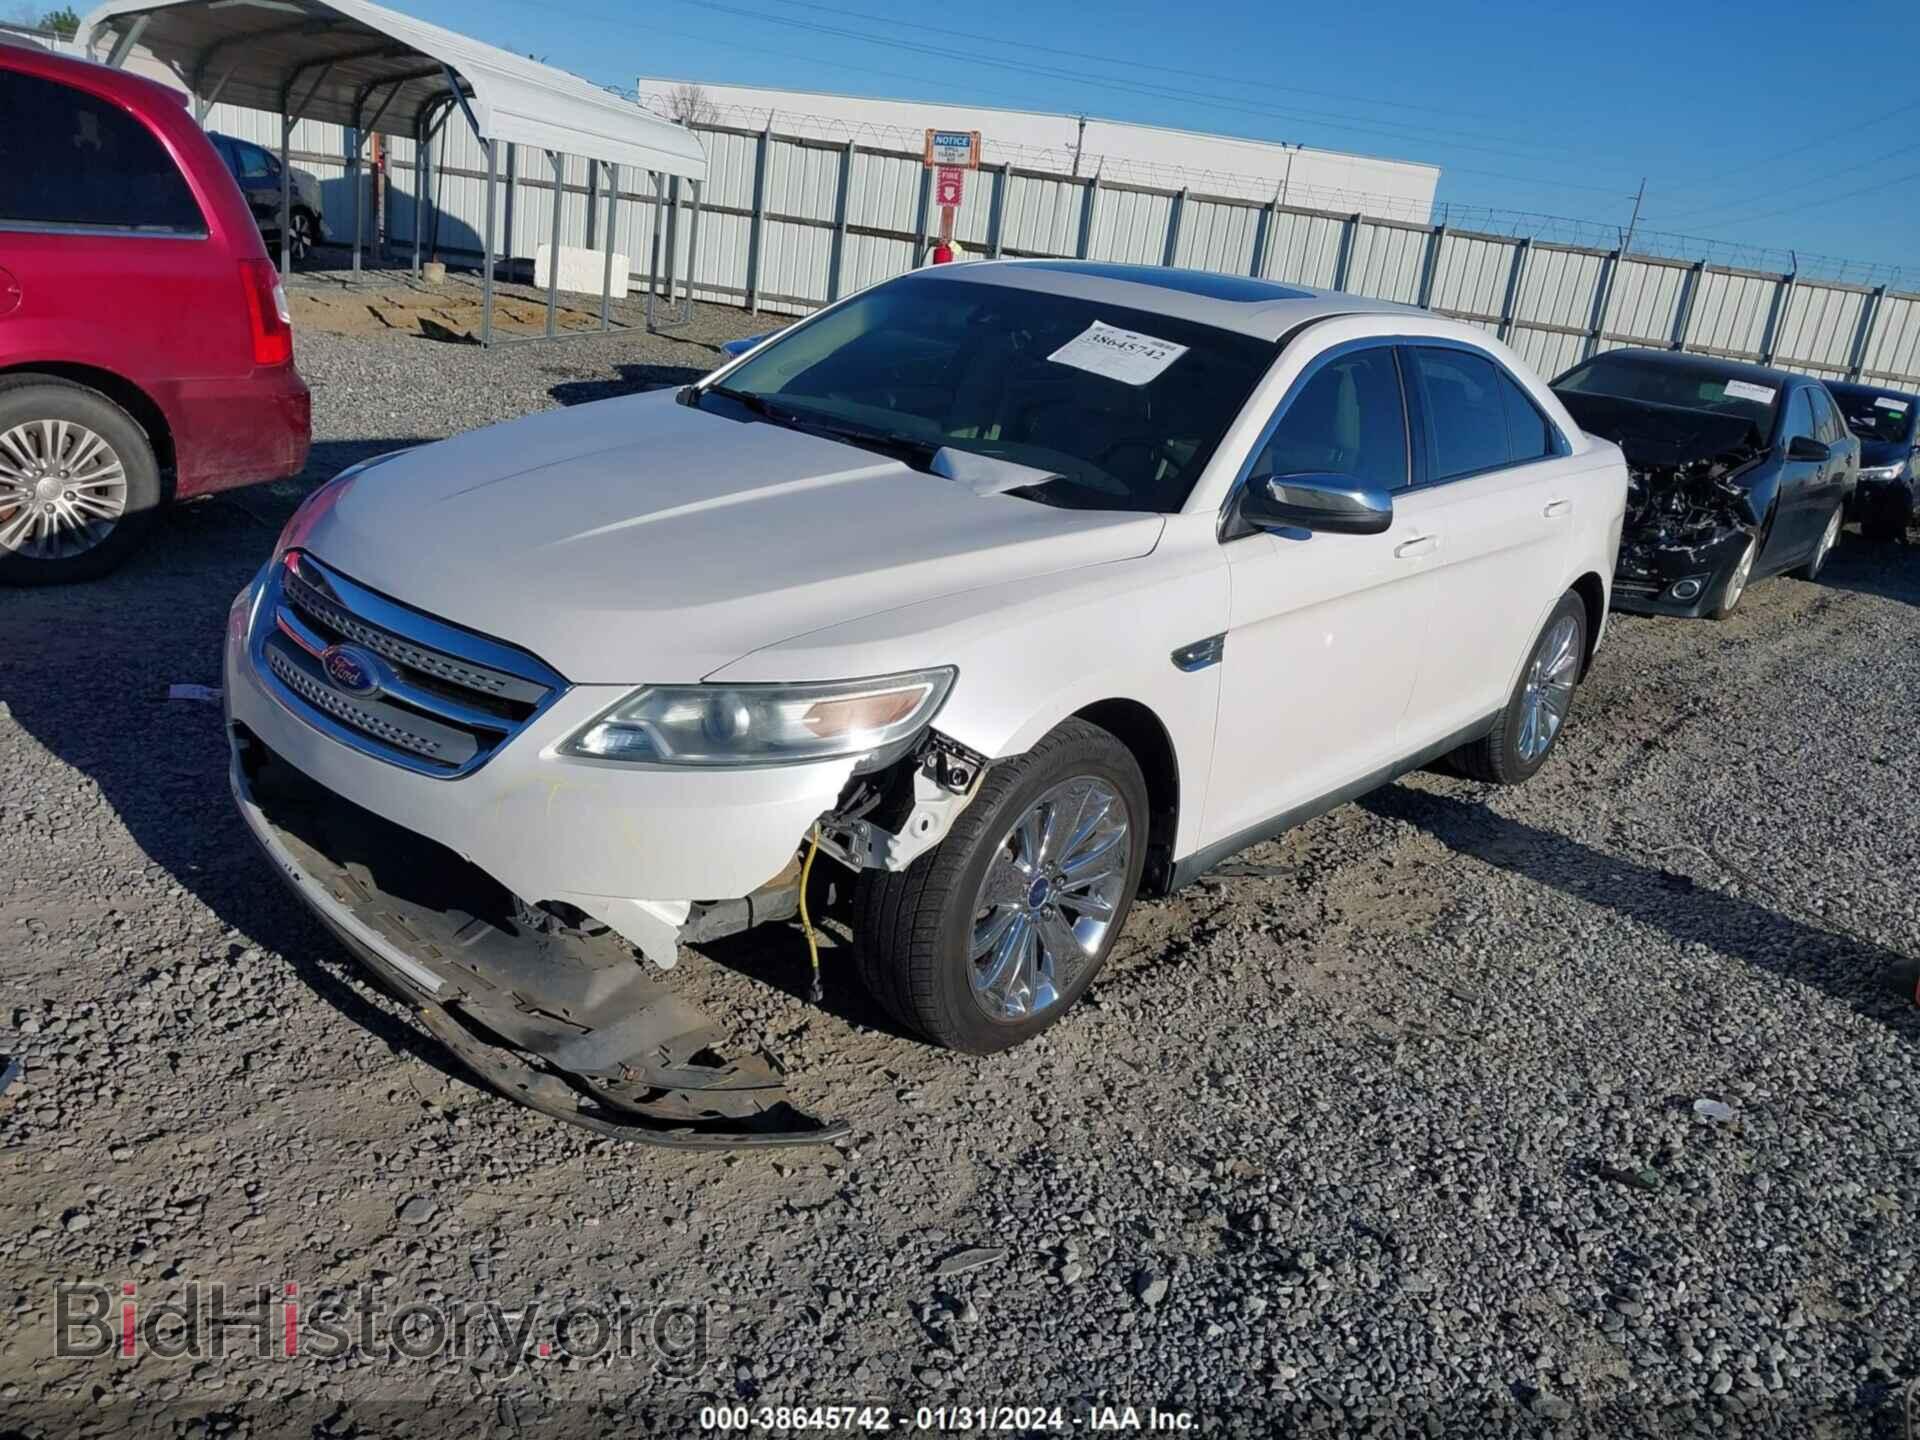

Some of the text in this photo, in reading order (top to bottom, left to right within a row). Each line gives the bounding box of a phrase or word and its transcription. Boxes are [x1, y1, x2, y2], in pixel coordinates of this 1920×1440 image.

[935, 136, 968, 145] NOTICE
[942, 171, 960, 180] FIRE
[1087, 333, 1166, 361] 38645742
[330, 656, 361, 686] Ford
